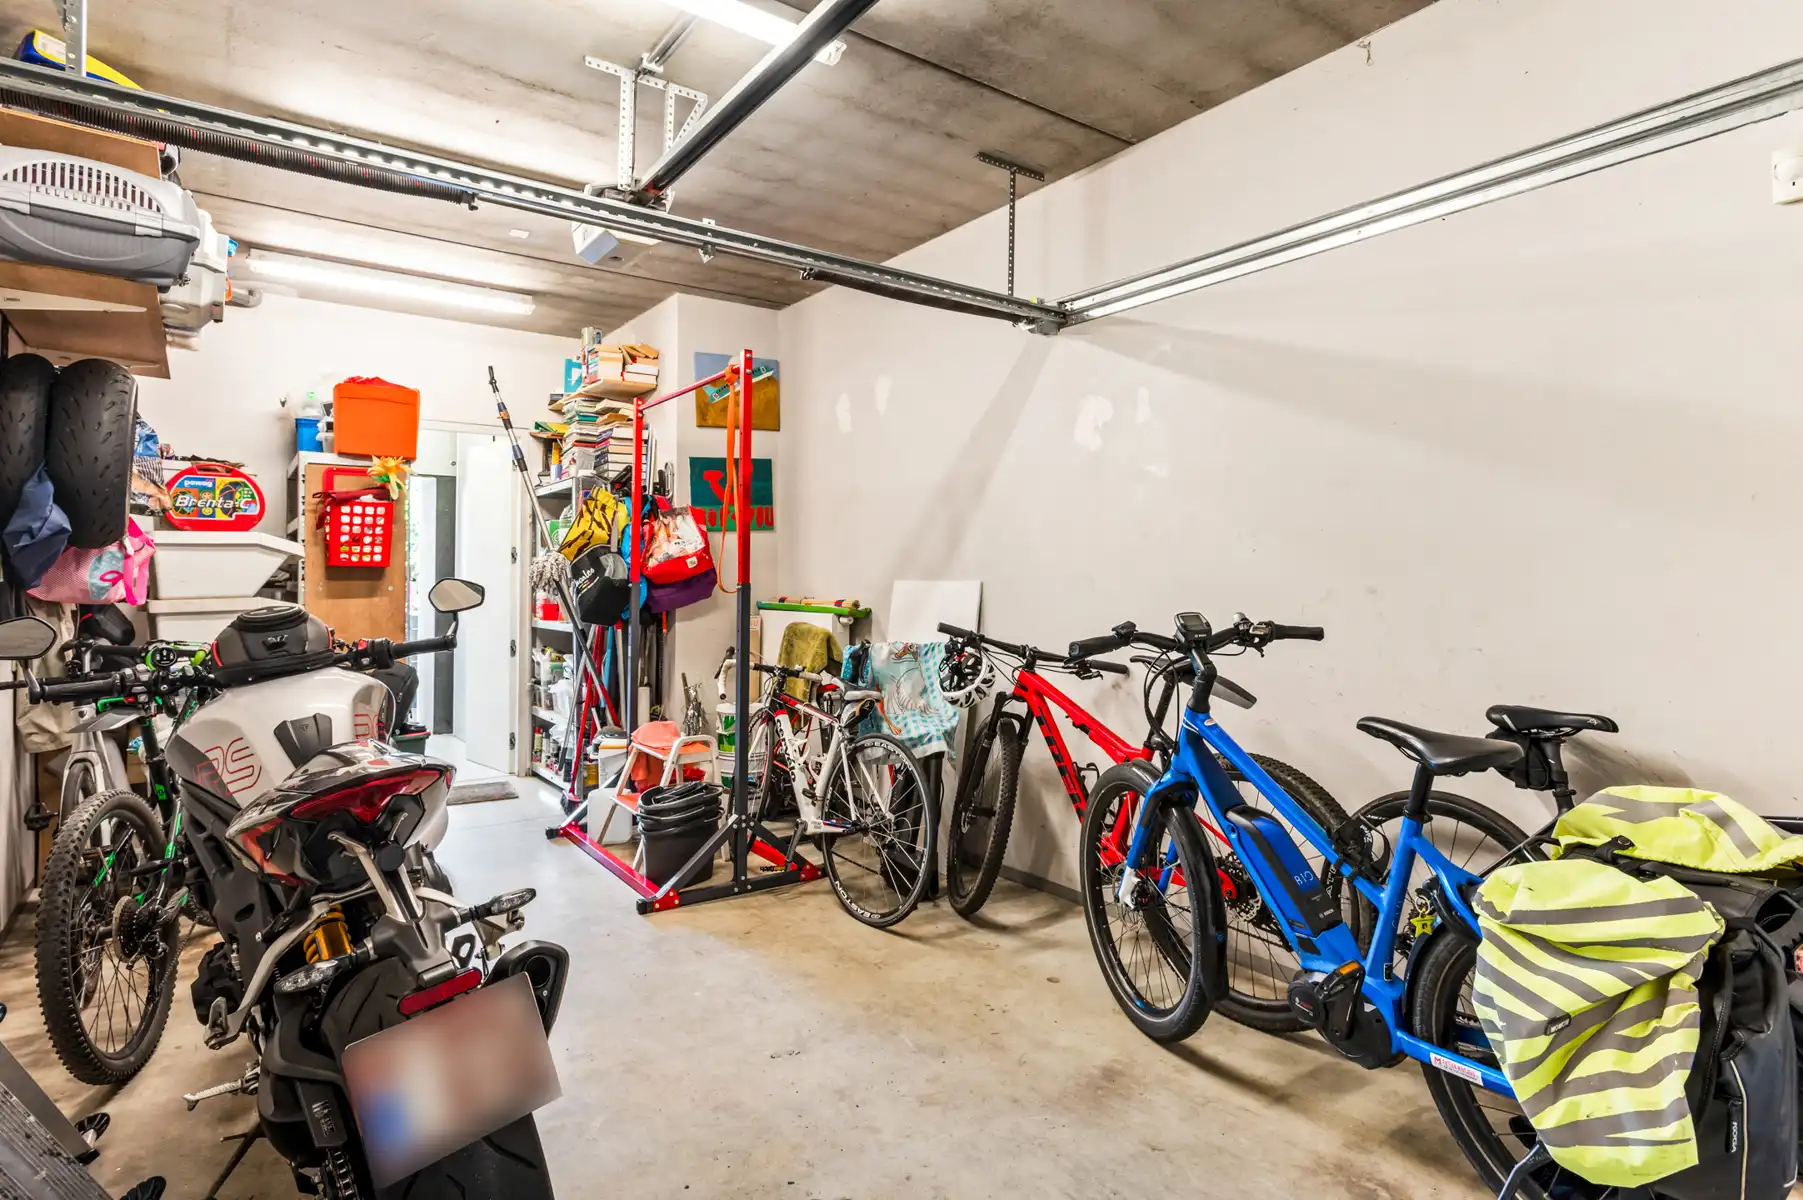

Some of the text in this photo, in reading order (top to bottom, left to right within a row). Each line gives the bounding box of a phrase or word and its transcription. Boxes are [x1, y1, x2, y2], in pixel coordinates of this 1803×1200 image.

[175, 495, 252, 510] Brenta-C
[194, 736, 262, 796] RS
[835, 881, 869, 918] EASTON
